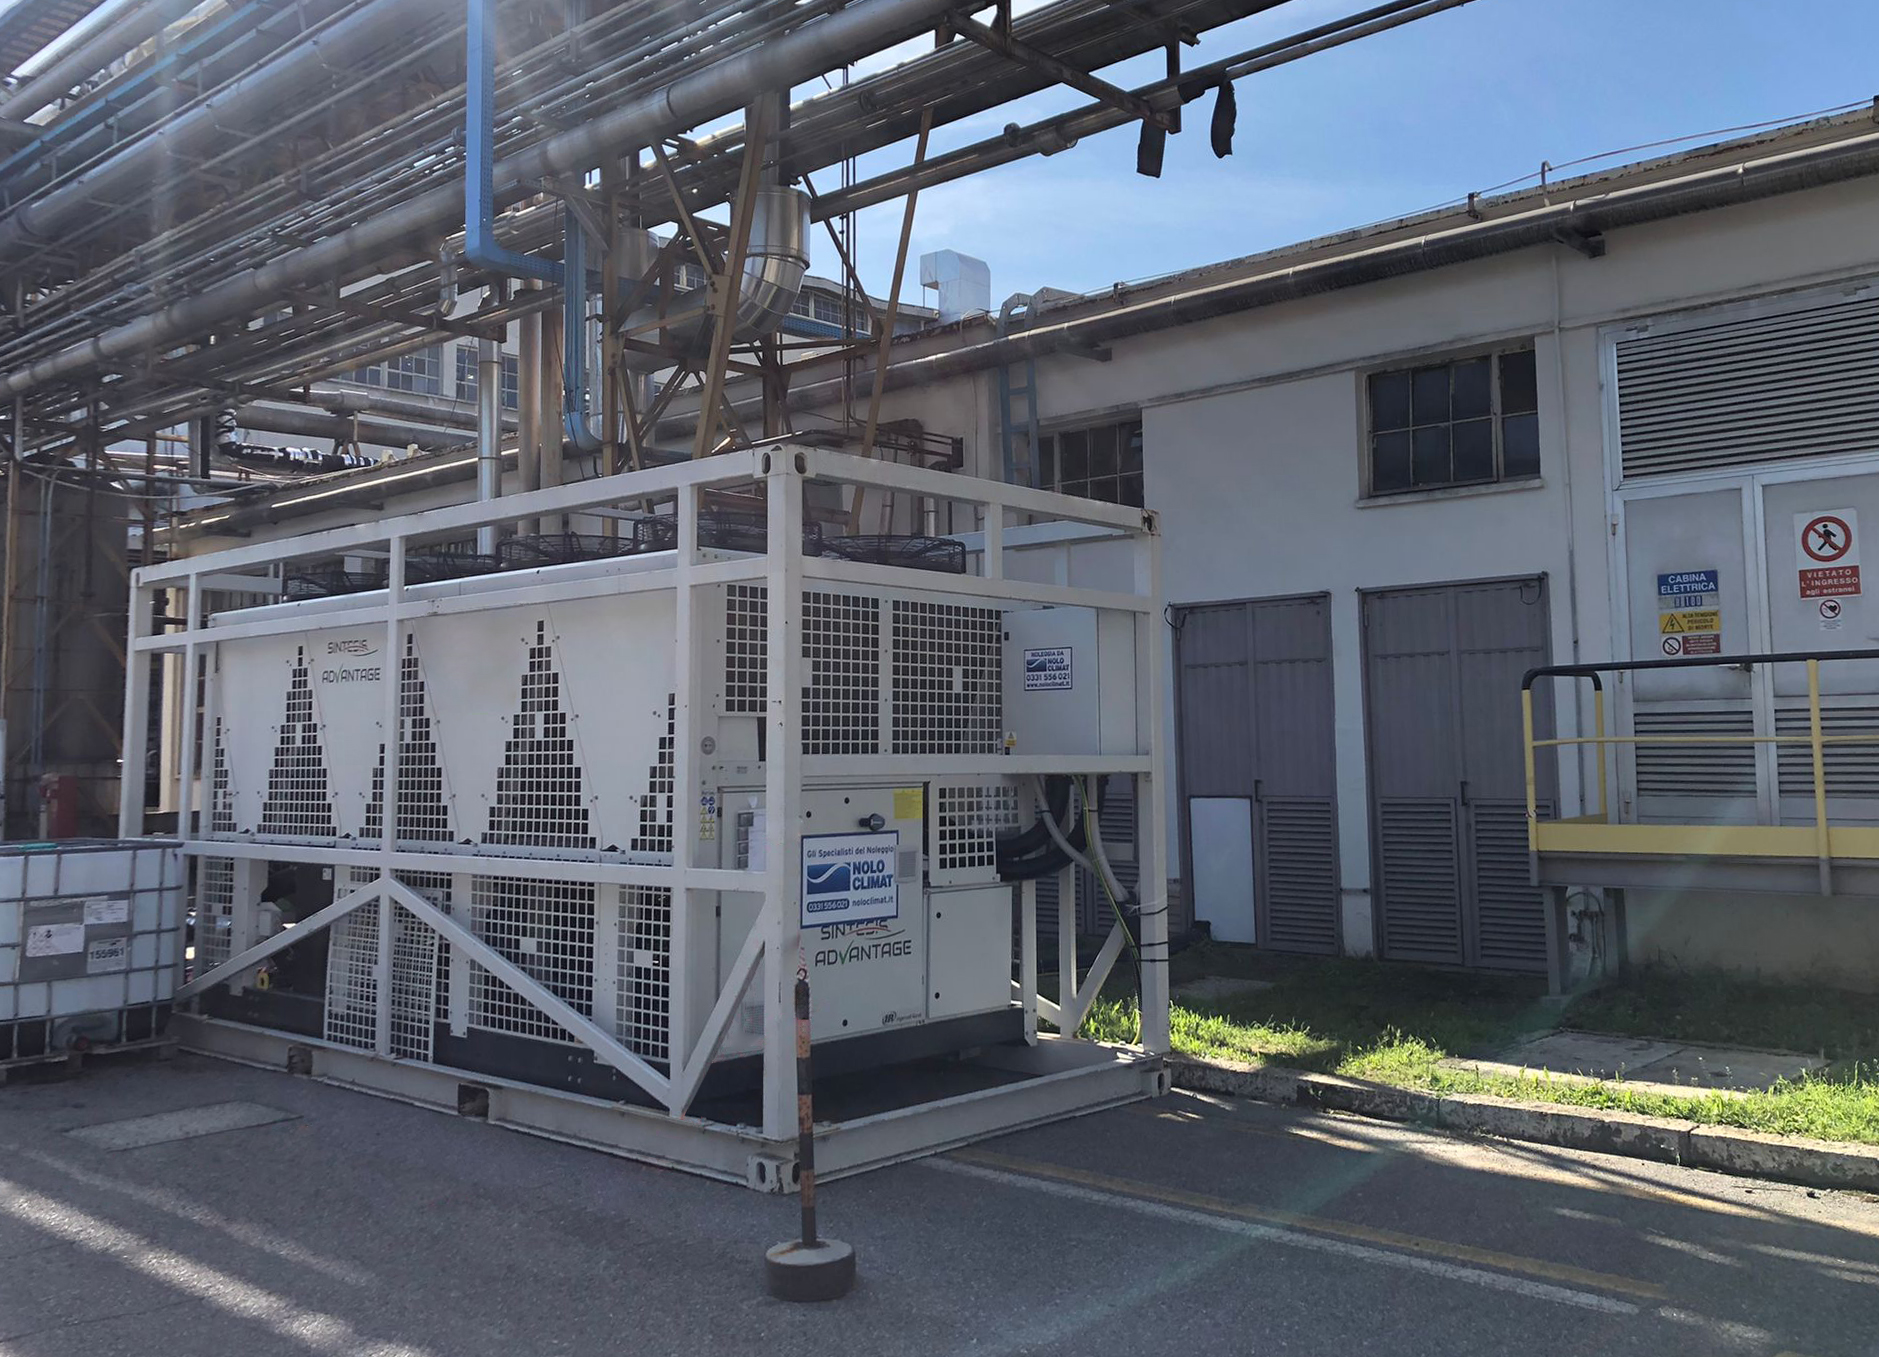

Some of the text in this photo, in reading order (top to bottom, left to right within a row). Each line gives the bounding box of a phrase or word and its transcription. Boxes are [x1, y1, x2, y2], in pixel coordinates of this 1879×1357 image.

[1668, 573, 1706, 583] CABINA
[1807, 569, 1851, 578] VIETATO
[1661, 582, 1716, 594] ELETTRICA
[322, 663, 381, 683] ADVANTAGE
[807, 844, 894, 858] Gli Specialisti del Noleggio
[852, 859, 885, 875] NOLO
[852, 874, 893, 890] CLIMAT
[852, 896, 893, 907] noloclimat.it
[815, 940, 912, 967] ADVANTAGE
